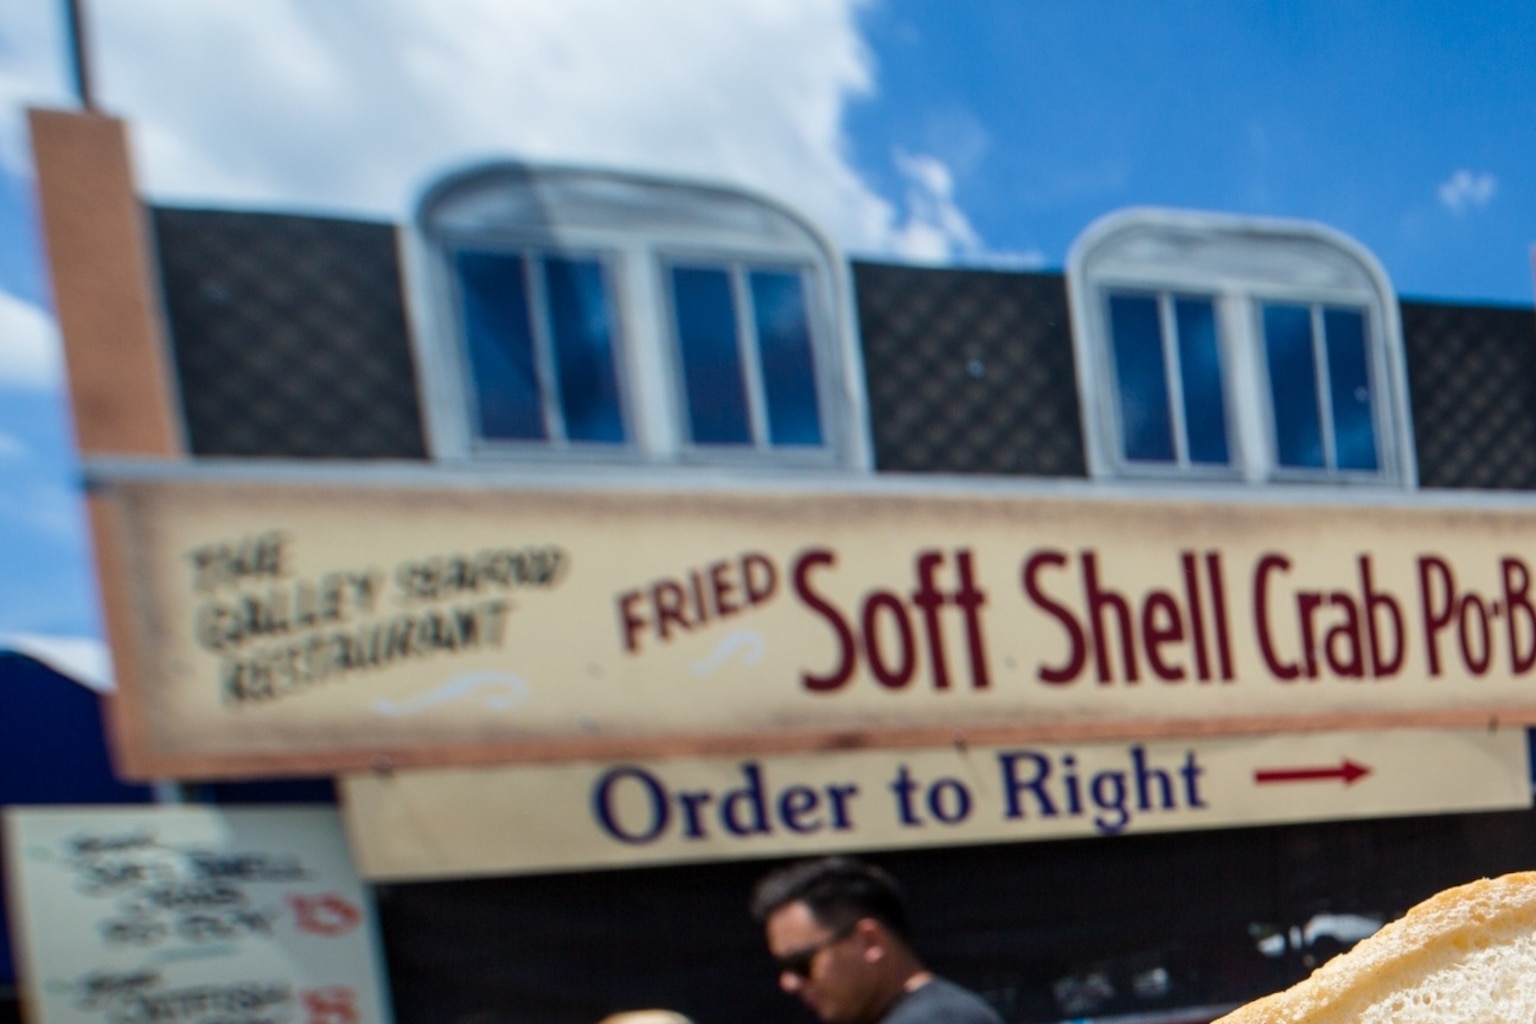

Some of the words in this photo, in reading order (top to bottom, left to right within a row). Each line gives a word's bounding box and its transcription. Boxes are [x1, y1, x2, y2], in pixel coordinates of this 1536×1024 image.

[219, 597, 514, 708] RESTAURANT
[617, 554, 776, 652] FRIED
[792, 549, 990, 694] Soft
[1021, 550, 1234, 685] Shell
[1252, 553, 1405, 682] Crab
[590, 760, 862, 846] Order
[890, 766, 973, 827] to
[999, 745, 1207, 836] Right
